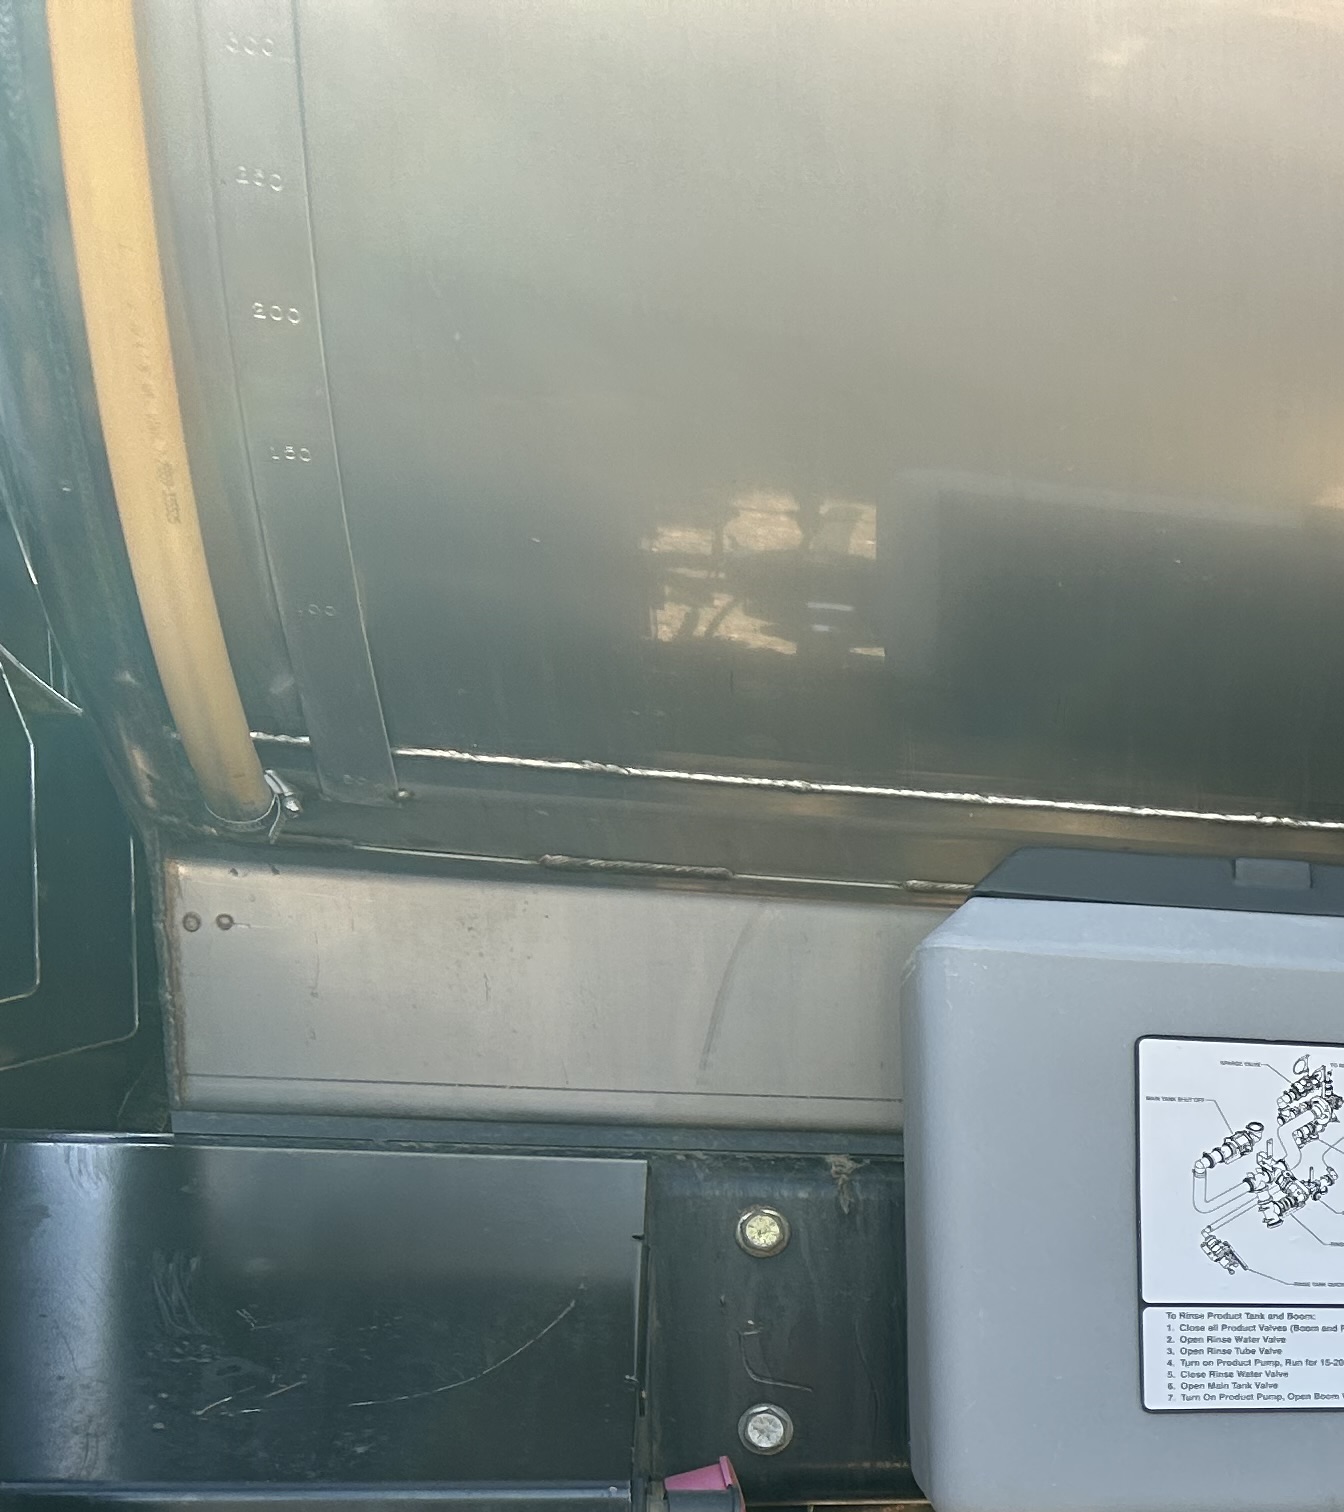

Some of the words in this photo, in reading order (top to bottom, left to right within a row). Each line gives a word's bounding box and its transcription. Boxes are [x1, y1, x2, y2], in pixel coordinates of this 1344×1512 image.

[1207, 1312, 1243, 1320] Product
[1221, 1324, 1257, 1332] Product
[1180, 1336, 1205, 1345] Open
[1180, 1347, 1205, 1356] Open
[1207, 1347, 1233, 1355] Rinse
[1234, 1347, 1257, 1355] Tube
[1259, 1347, 1283, 1355] Valve
[1180, 1359, 1200, 1368] Turn
[1236, 1370, 1263, 1378] Water
[1264, 1370, 1289, 1378] Valve
[1181, 1382, 1205, 1391] Open
[1287, 1393, 1312, 1401] Open
